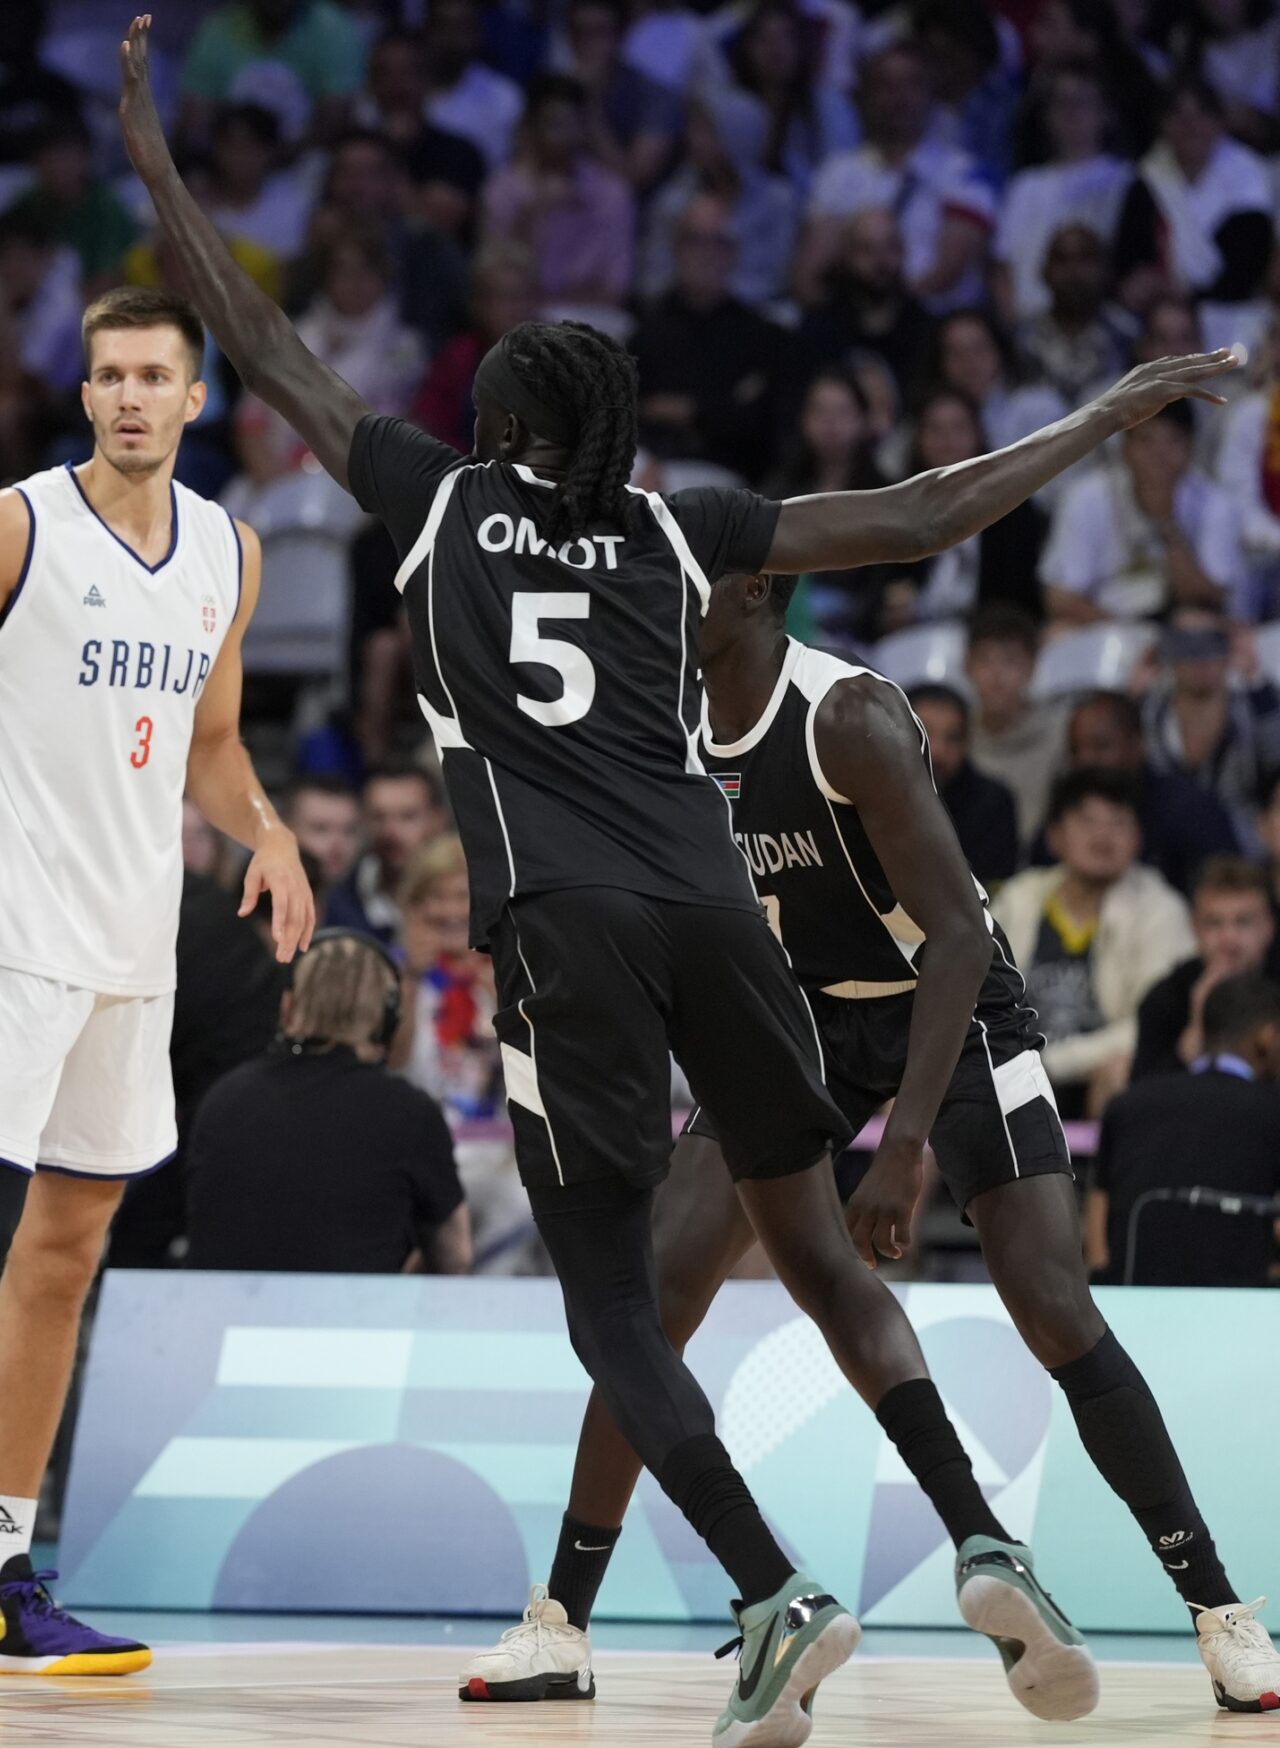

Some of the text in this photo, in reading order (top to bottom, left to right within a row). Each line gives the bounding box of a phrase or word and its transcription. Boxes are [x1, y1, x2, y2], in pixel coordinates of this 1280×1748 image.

[477, 513, 626, 570] OMOT
[509, 591, 596, 727] 5
[130, 715, 154, 769] 3
